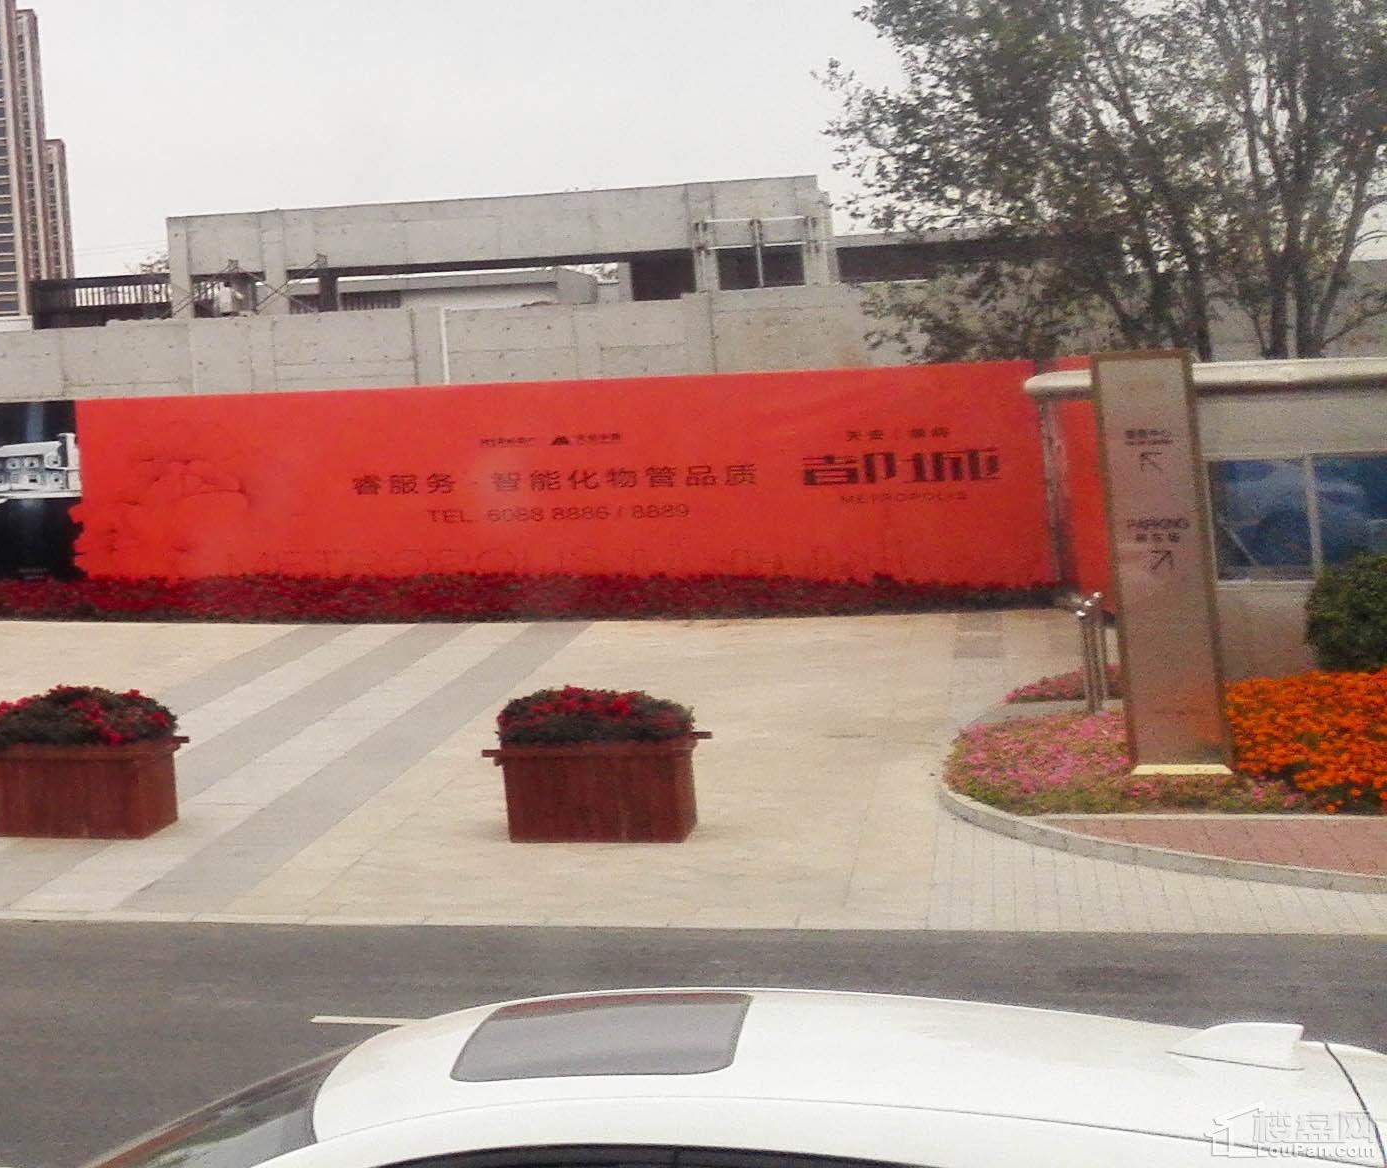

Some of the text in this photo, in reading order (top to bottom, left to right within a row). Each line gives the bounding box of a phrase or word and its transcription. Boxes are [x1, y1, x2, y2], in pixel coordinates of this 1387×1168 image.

[486, 507, 545, 523] 6088
[551, 506, 610, 521] 8886
[631, 503, 690, 520] 8889
